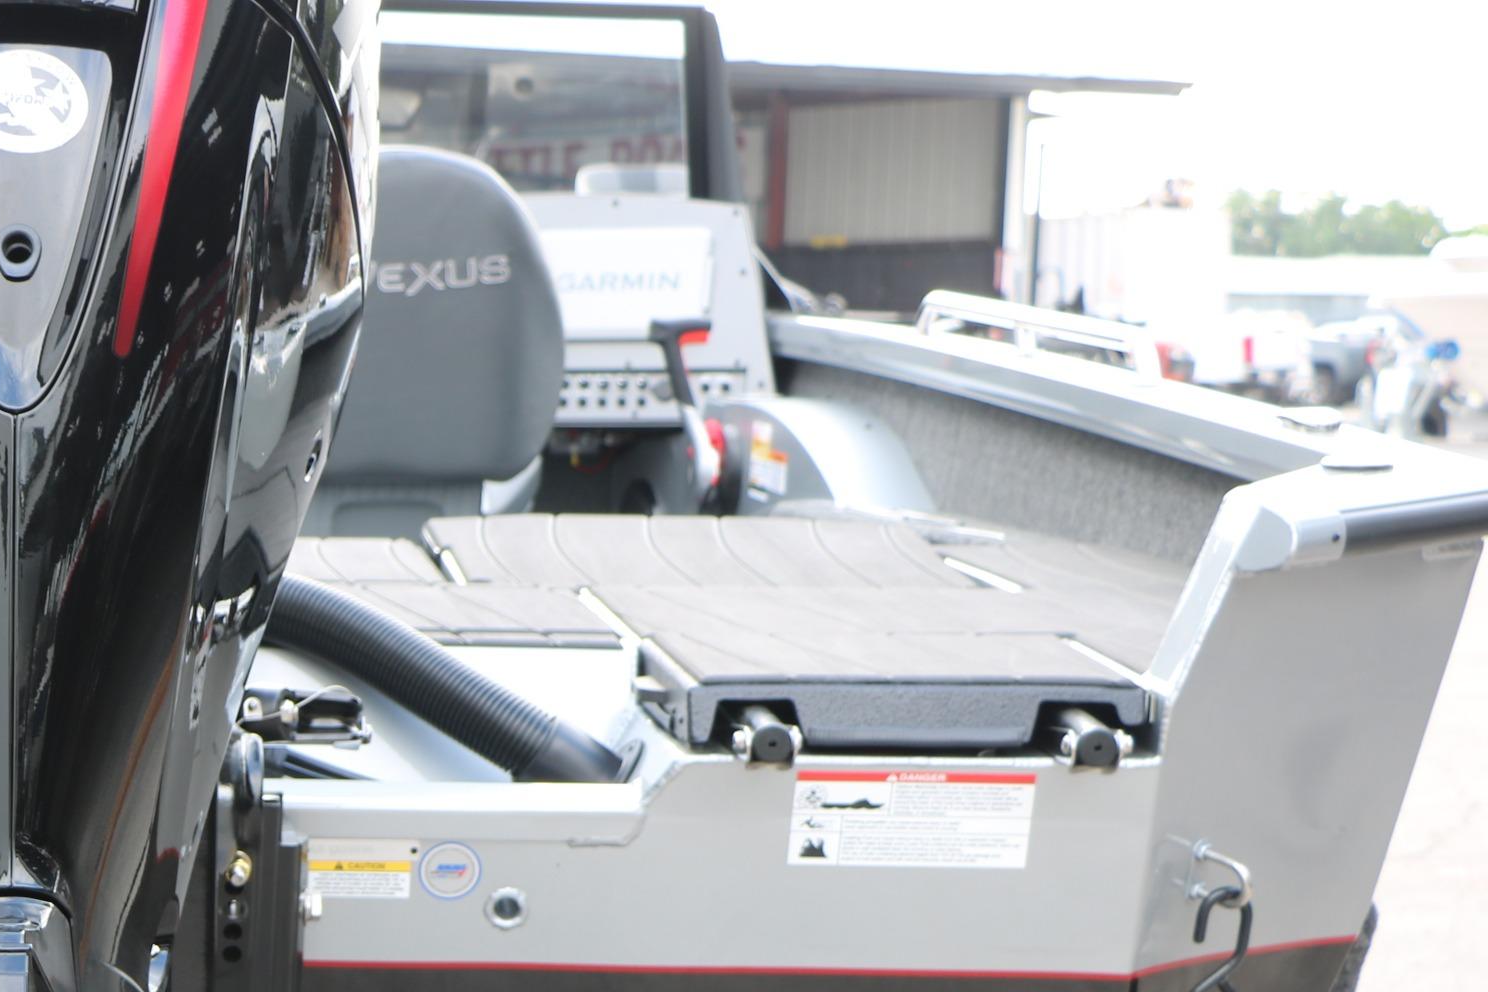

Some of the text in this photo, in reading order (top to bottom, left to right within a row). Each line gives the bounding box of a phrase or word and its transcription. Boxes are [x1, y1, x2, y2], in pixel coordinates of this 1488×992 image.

[369, 254, 511, 297] EXUS
[559, 271, 681, 292] GARMIN
[899, 773, 947, 782] DANGER
[348, 862, 386, 870] CAUTION
